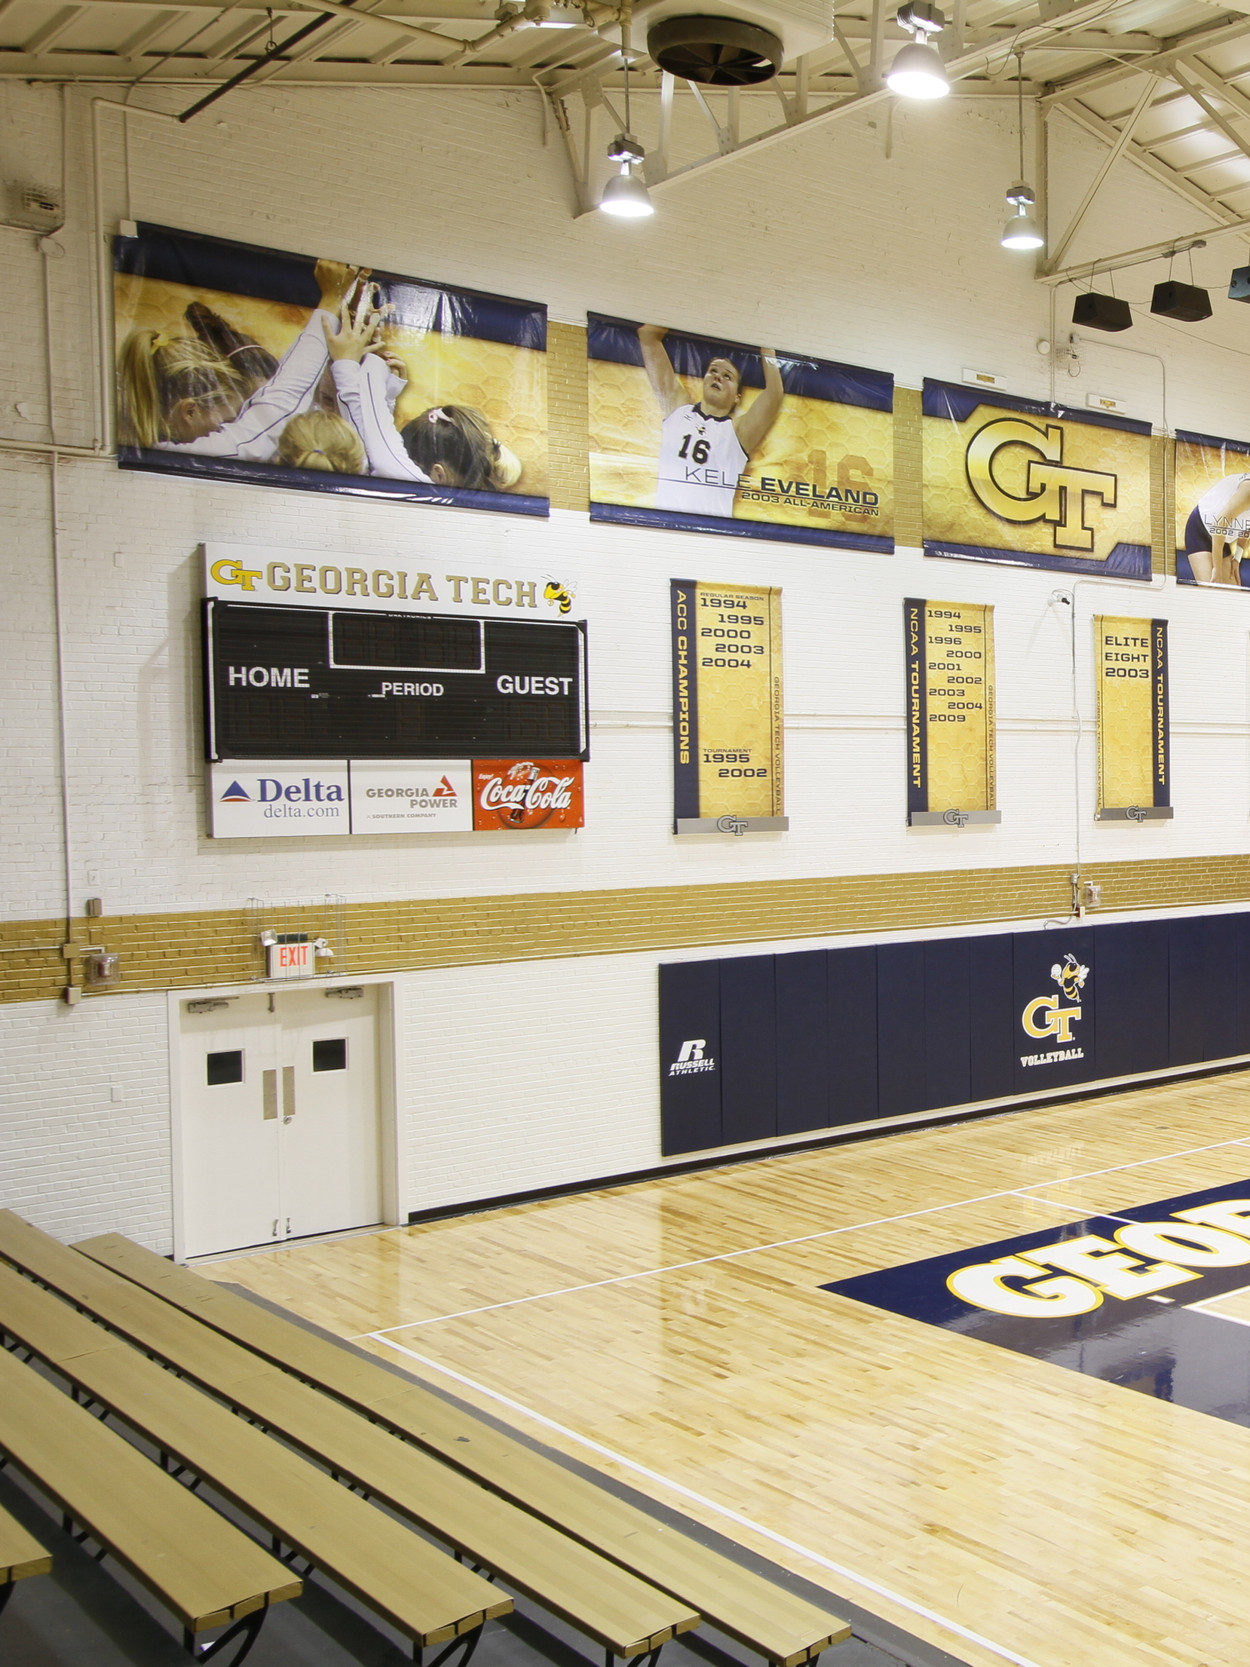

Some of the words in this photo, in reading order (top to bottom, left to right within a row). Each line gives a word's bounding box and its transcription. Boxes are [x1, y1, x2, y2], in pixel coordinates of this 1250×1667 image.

[677, 434, 711, 464] 16
[685, 465, 750, 490] KELE
[760, 476, 880, 507] EVELAND
[965, 416, 1118, 552] GT
[741, 491, 780, 504] 2003
[783, 498, 880, 517] ALL-AMERICAN
[1209, 526, 1234, 537] 2002
[211, 559, 263, 591] GT
[267, 561, 438, 601] GEORGIA
[445, 574, 537, 608] TECH
[700, 597, 748, 609] 1994
[677, 590, 687, 630] ACC
[927, 609, 961, 620] 1994
[718, 613, 765, 626] 1995
[700, 627, 752, 639] 2000
[910, 608, 919, 656] NCAA
[948, 624, 982, 634] 1995
[928, 636, 962, 645] 1996
[1105, 635, 1149, 648] ELITE
[715, 643, 765, 655] 2003
[946, 650, 982, 659] 2000
[1156, 627, 1164, 670] NCAA
[701, 657, 752, 669] 2004
[1105, 652, 1149, 663] EIGHT
[928, 662, 962, 671] 2001
[1105, 667, 1149, 679] 2003
[228, 665, 311, 688] HOME
[947, 676, 982, 685] 2002
[381, 681, 444, 697] PERIOD
[497, 674, 573, 696] GUEST
[928, 688, 965, 697] 2003
[678, 636, 690, 765] CHAMPIONS
[947, 702, 983, 710] 2004
[910, 660, 921, 788] TOURNAMENT
[929, 714, 966, 723] 2009
[1157, 673, 1165, 785] TOURNAMENT
[703, 753, 750, 763] 1995
[718, 768, 768, 778] 2002
[256, 778, 345, 803] Delta
[366, 788, 430, 798] GEORGIA
[480, 776, 576, 811] Coca-Cola
[409, 799, 458, 809] POWER
[263, 804, 340, 818] delta.com
[280, 946, 308, 967] EXIT
[1021, 994, 1082, 1043] GT
[1020, 1047, 1084, 1067] VOLLEYBALL
[668, 1065, 715, 1076] ATHLETIC
[669, 1058, 715, 1071] RUSSELL
